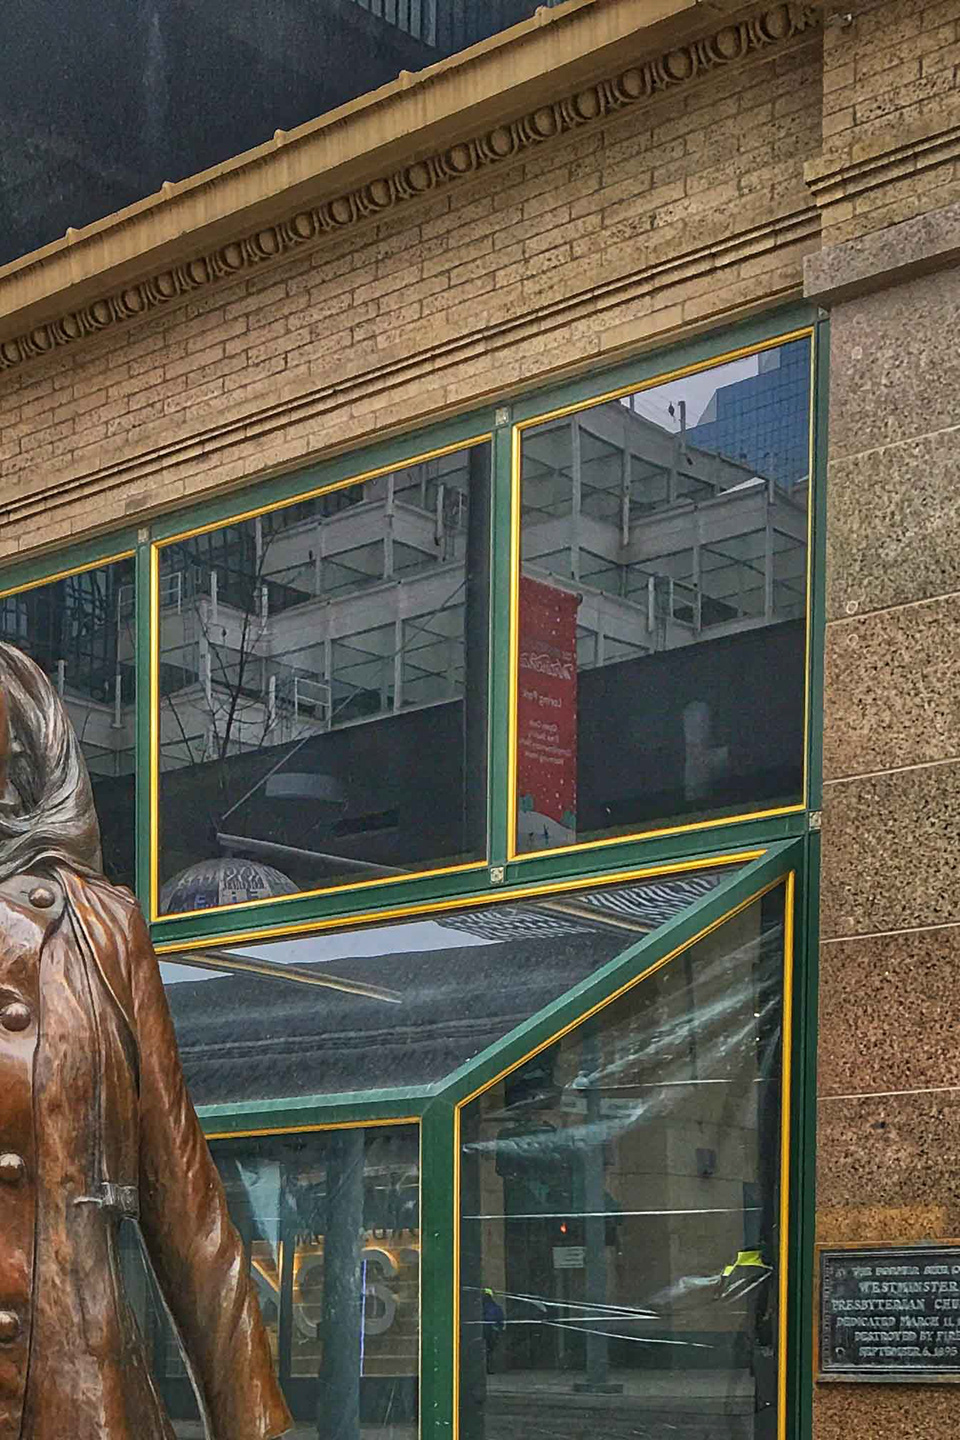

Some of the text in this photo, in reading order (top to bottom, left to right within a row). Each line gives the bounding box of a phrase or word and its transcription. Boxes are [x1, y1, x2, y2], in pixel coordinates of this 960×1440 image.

[858, 1281, 959, 1293] WESTMINSTER
[830, 1298, 960, 1311] PRESBYTERIAN CHU
[836, 1316, 897, 1328] DEDICATED
[900, 1315, 940, 1328] MARCH
[854, 1331, 918, 1341] DESTROYED
[919, 1331, 933, 1341] BY
[859, 1346, 921, 1357] SEPTEMBER
